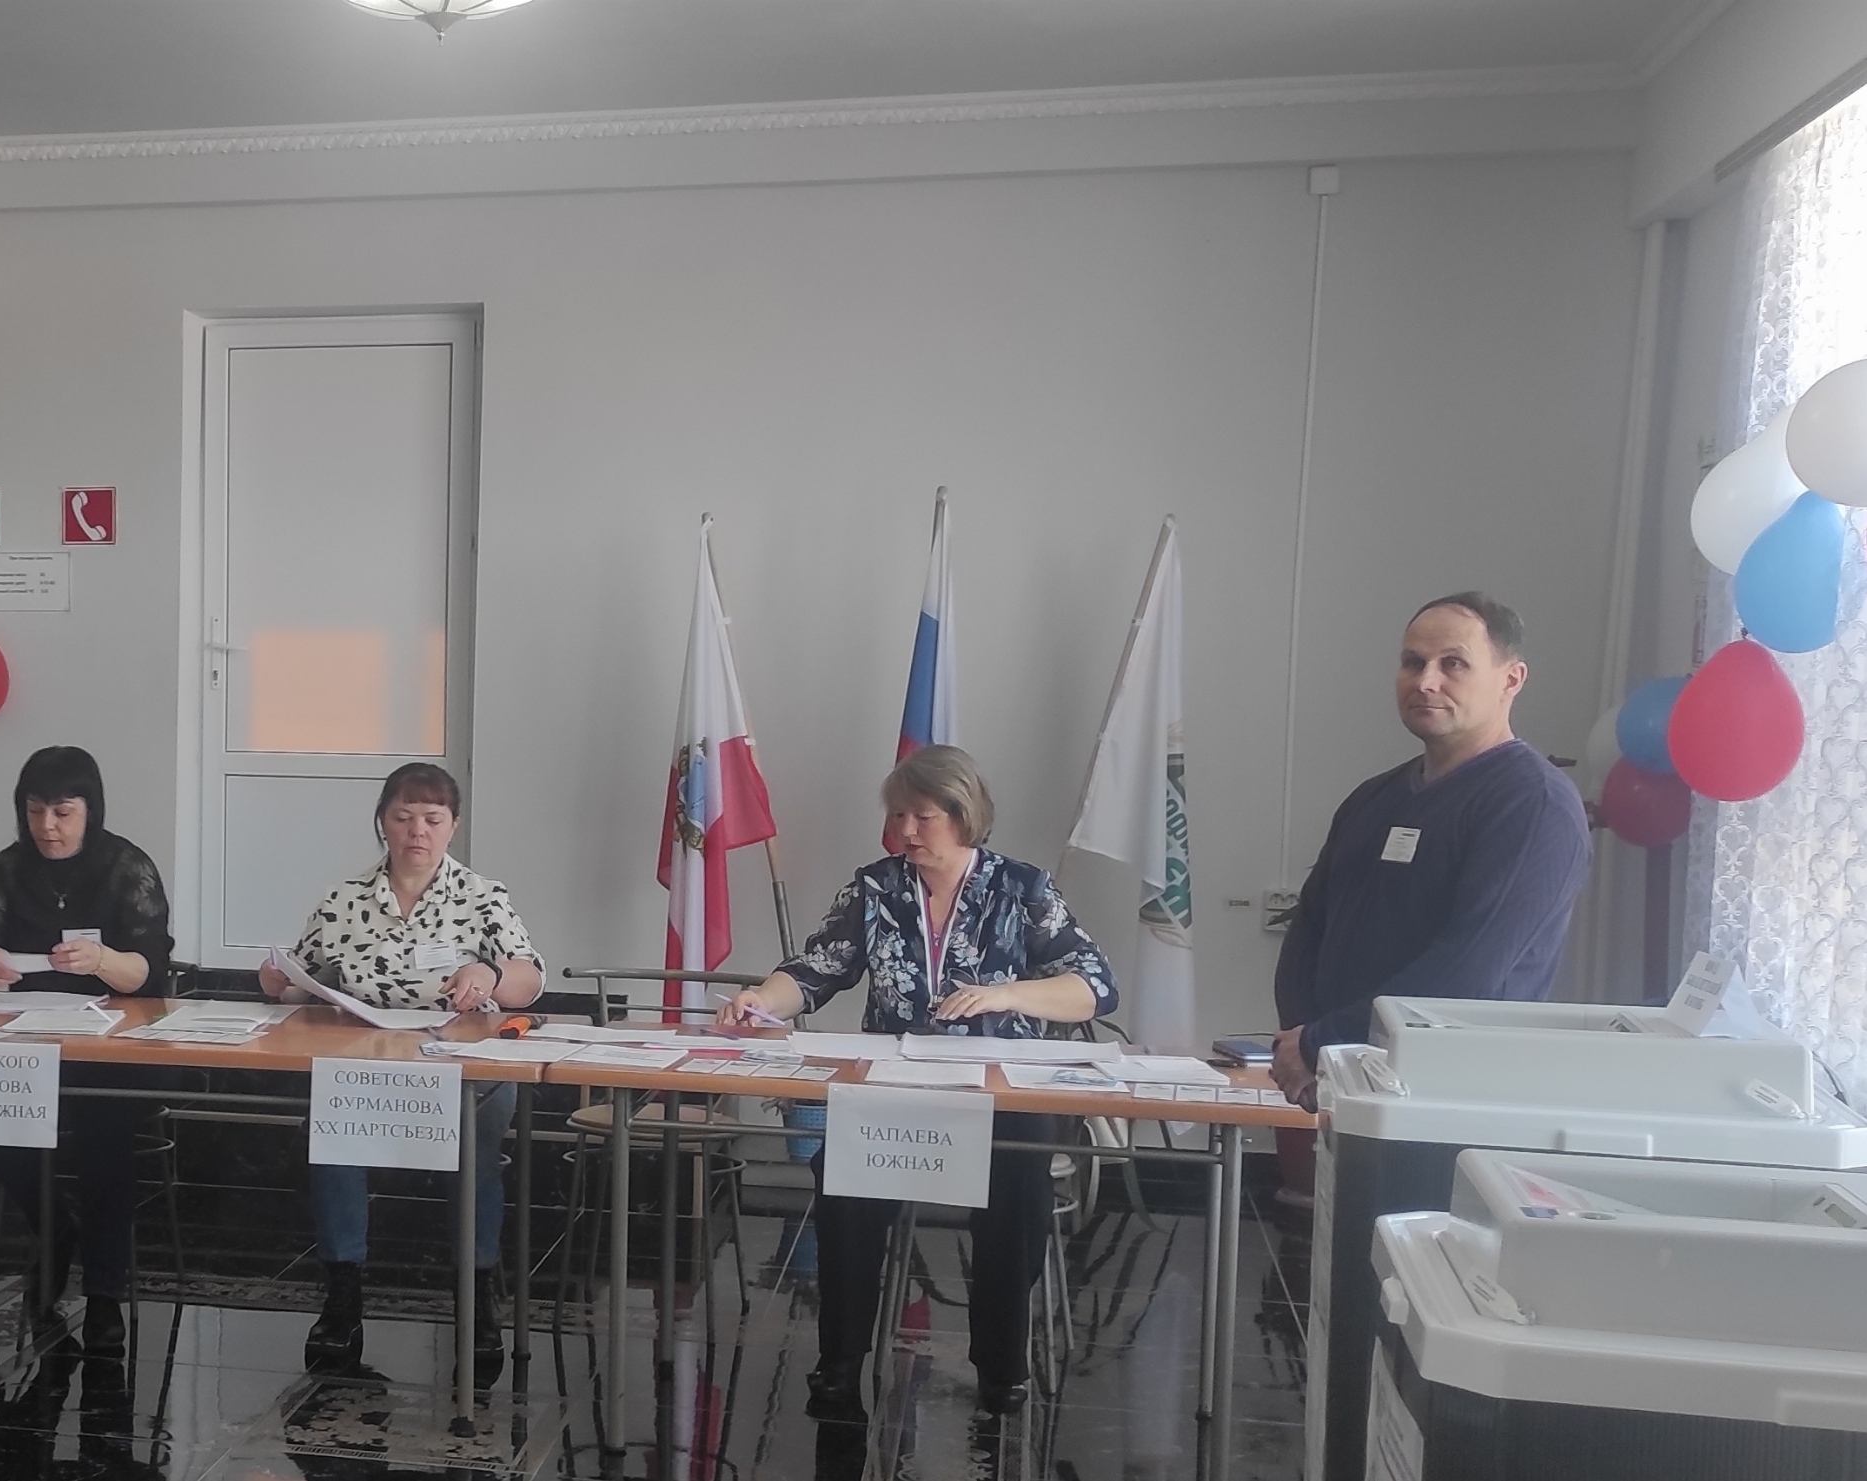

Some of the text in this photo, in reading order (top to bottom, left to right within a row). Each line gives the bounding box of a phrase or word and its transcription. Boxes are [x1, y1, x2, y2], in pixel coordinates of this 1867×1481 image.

[334, 1070, 441, 1089] СОВЕТСКАЯ
[329, 1096, 444, 1115] ФУРМАНОВА
[344, 1121, 458, 1142] ПАРТСЪЕЗДА
[859, 1125, 953, 1147] ЧАПАЕВА
[866, 1153, 944, 1173] ЮЖНАЯ
